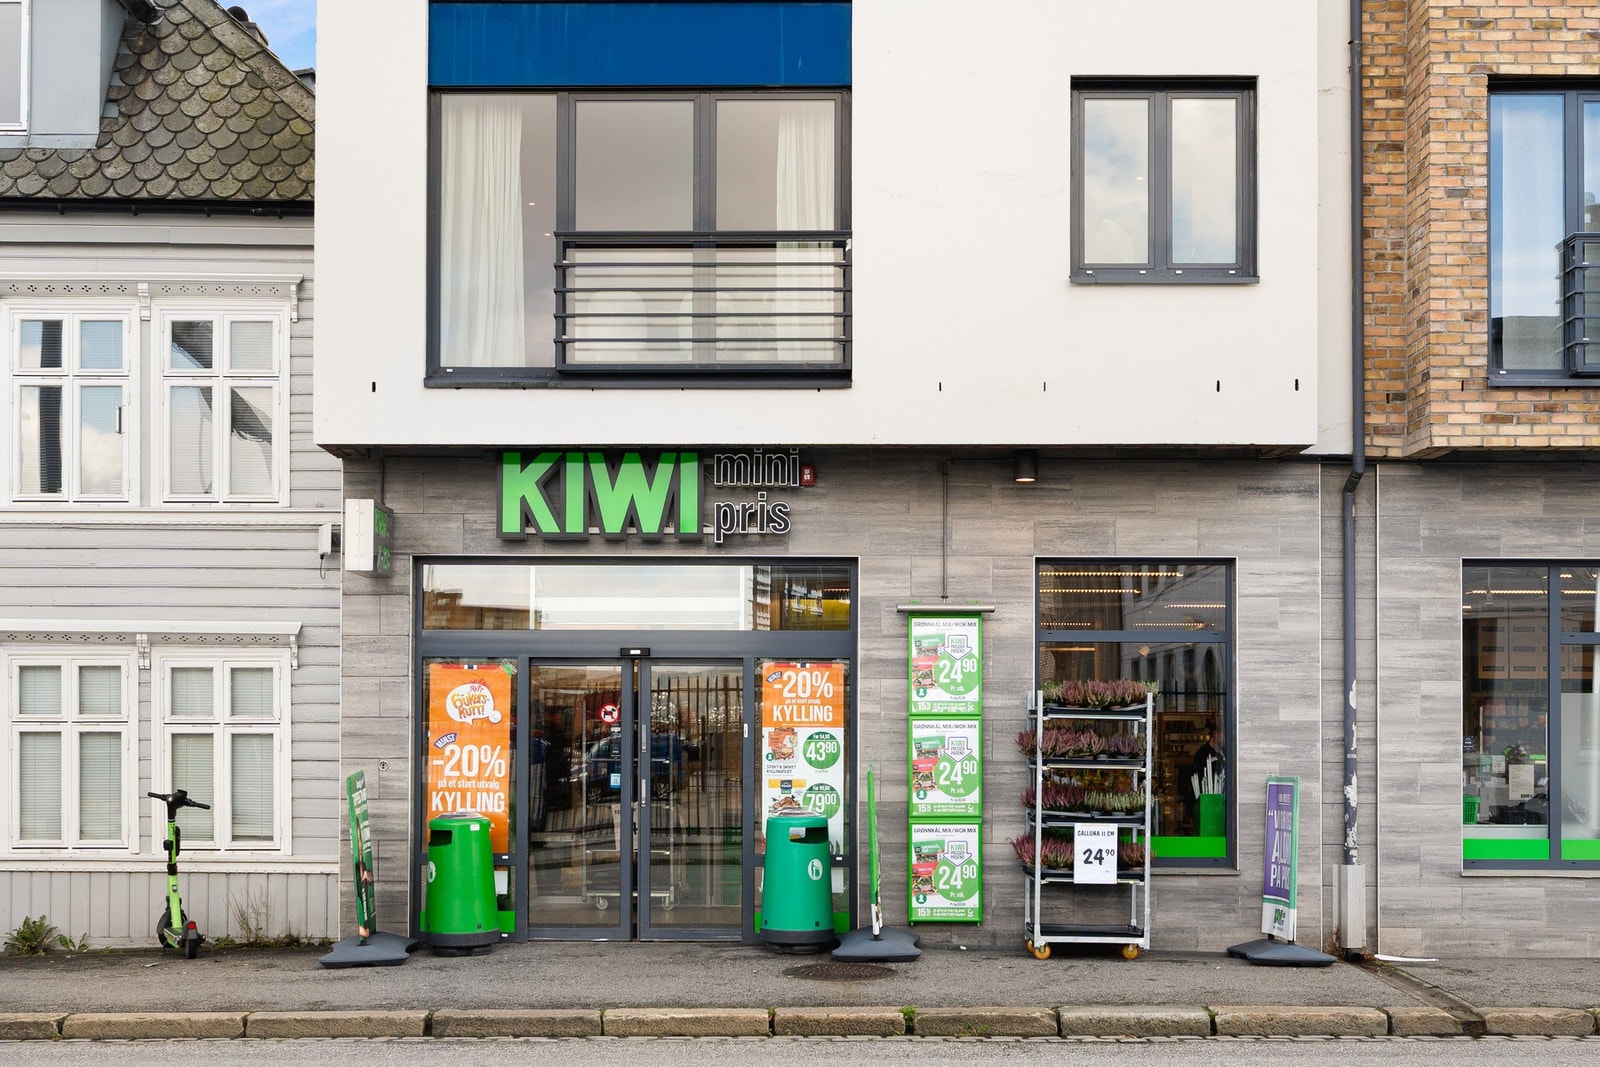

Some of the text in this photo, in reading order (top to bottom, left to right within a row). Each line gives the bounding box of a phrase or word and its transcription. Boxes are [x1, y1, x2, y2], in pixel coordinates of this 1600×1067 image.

[499, 448, 800, 538] KIWI mini
[713, 491, 792, 543] pris
[773, 670, 833, 698] -20%
[773, 705, 833, 722] KYLLING
[435, 733, 457, 749] MINST
[432, 744, 506, 778] -20%
[437, 780, 500, 790] på et stort utvalg
[431, 791, 505, 812] KYLLING
